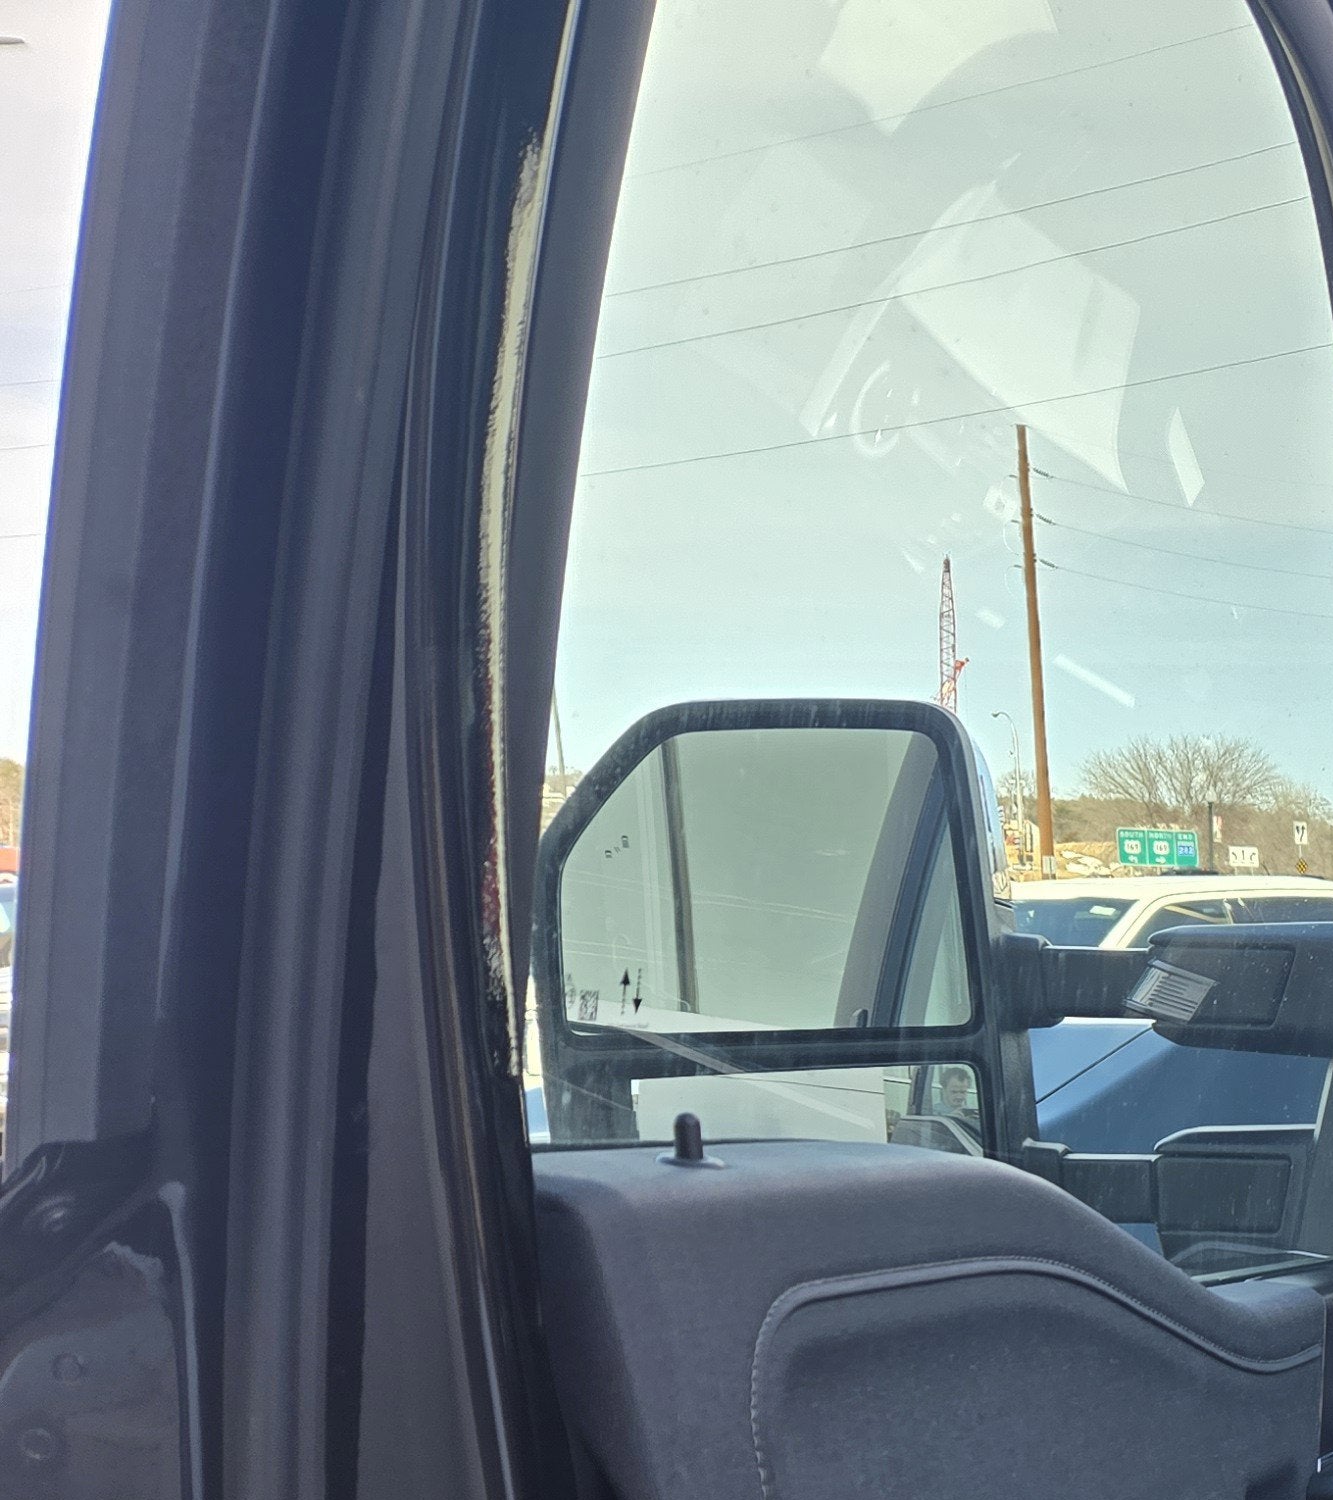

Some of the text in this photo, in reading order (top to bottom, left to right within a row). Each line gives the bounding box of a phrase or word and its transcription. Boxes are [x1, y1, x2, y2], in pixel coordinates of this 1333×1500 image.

[1119, 831, 1144, 839] SOUTH
[1126, 843, 1138, 851] 169
[1156, 844, 1168, 852] 169
